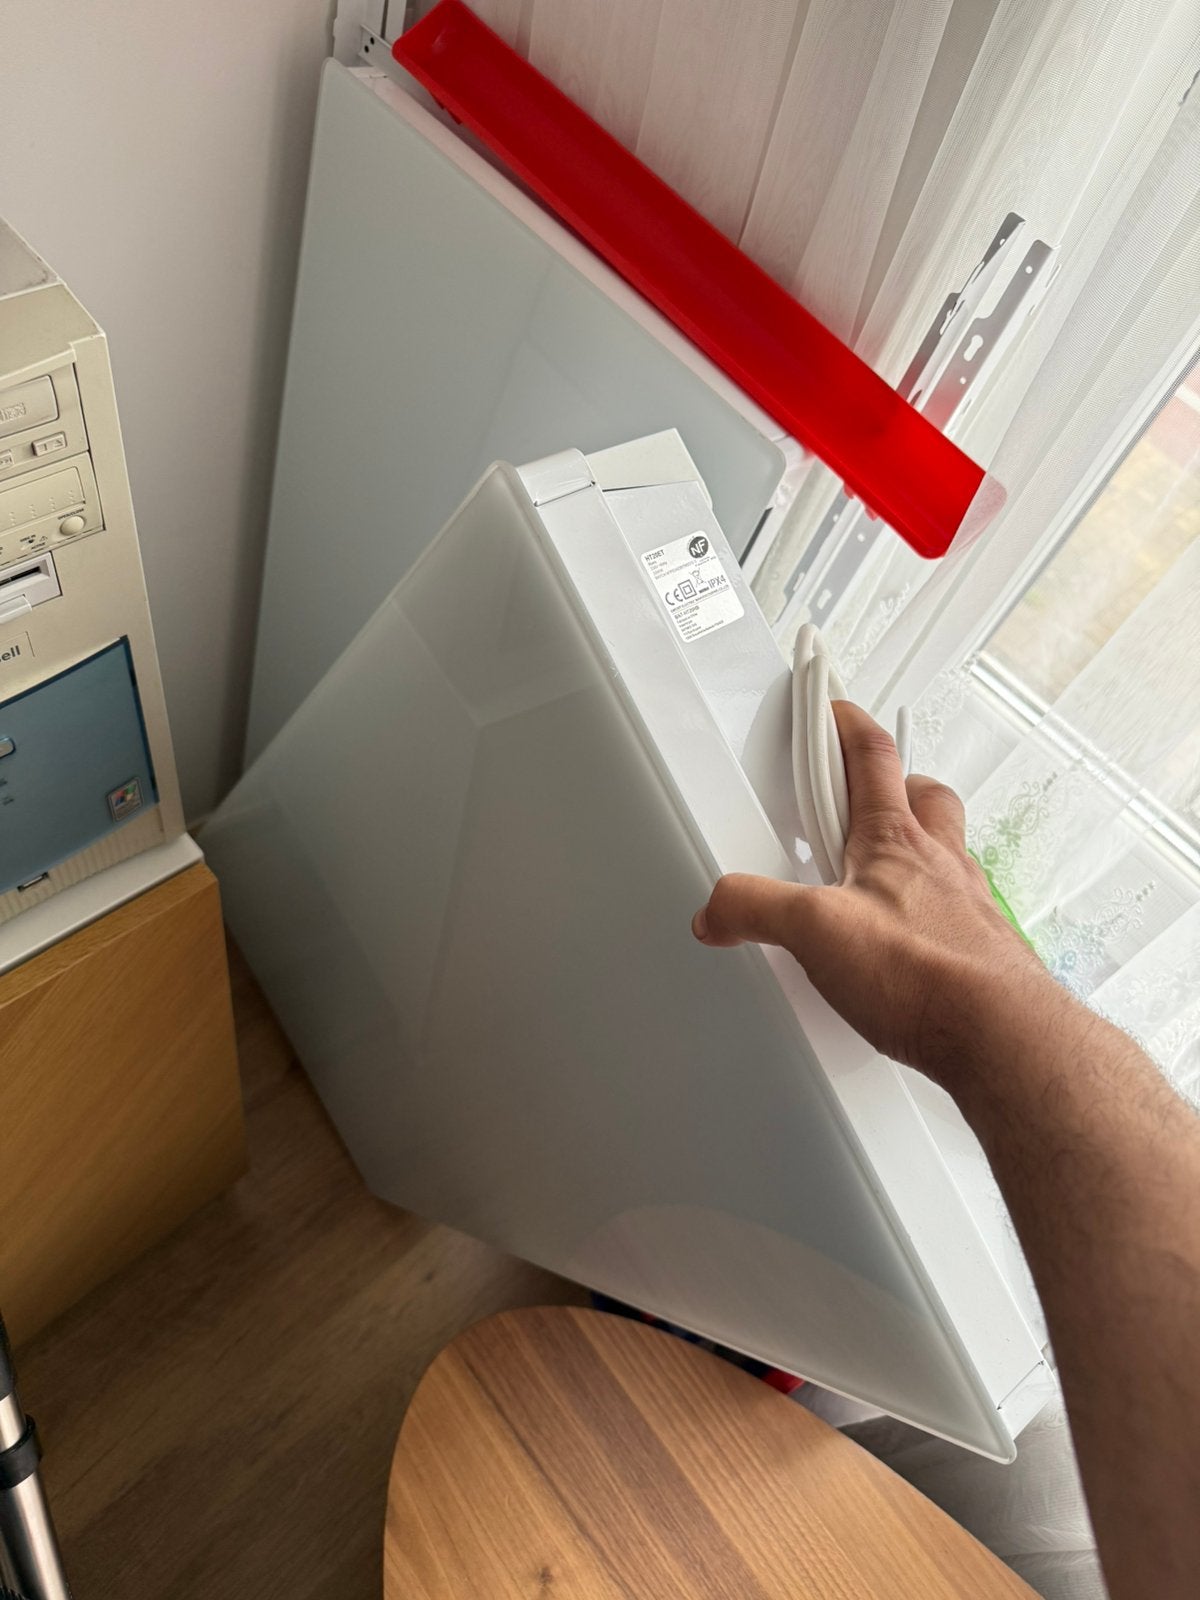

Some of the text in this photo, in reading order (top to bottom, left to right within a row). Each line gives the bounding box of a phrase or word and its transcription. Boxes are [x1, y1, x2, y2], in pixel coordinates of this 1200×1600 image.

[690, 539, 706, 556] NF
[709, 575, 727, 588] IPX4
[665, 588, 683, 606] CE
[0, 644, 21, 662] ell
